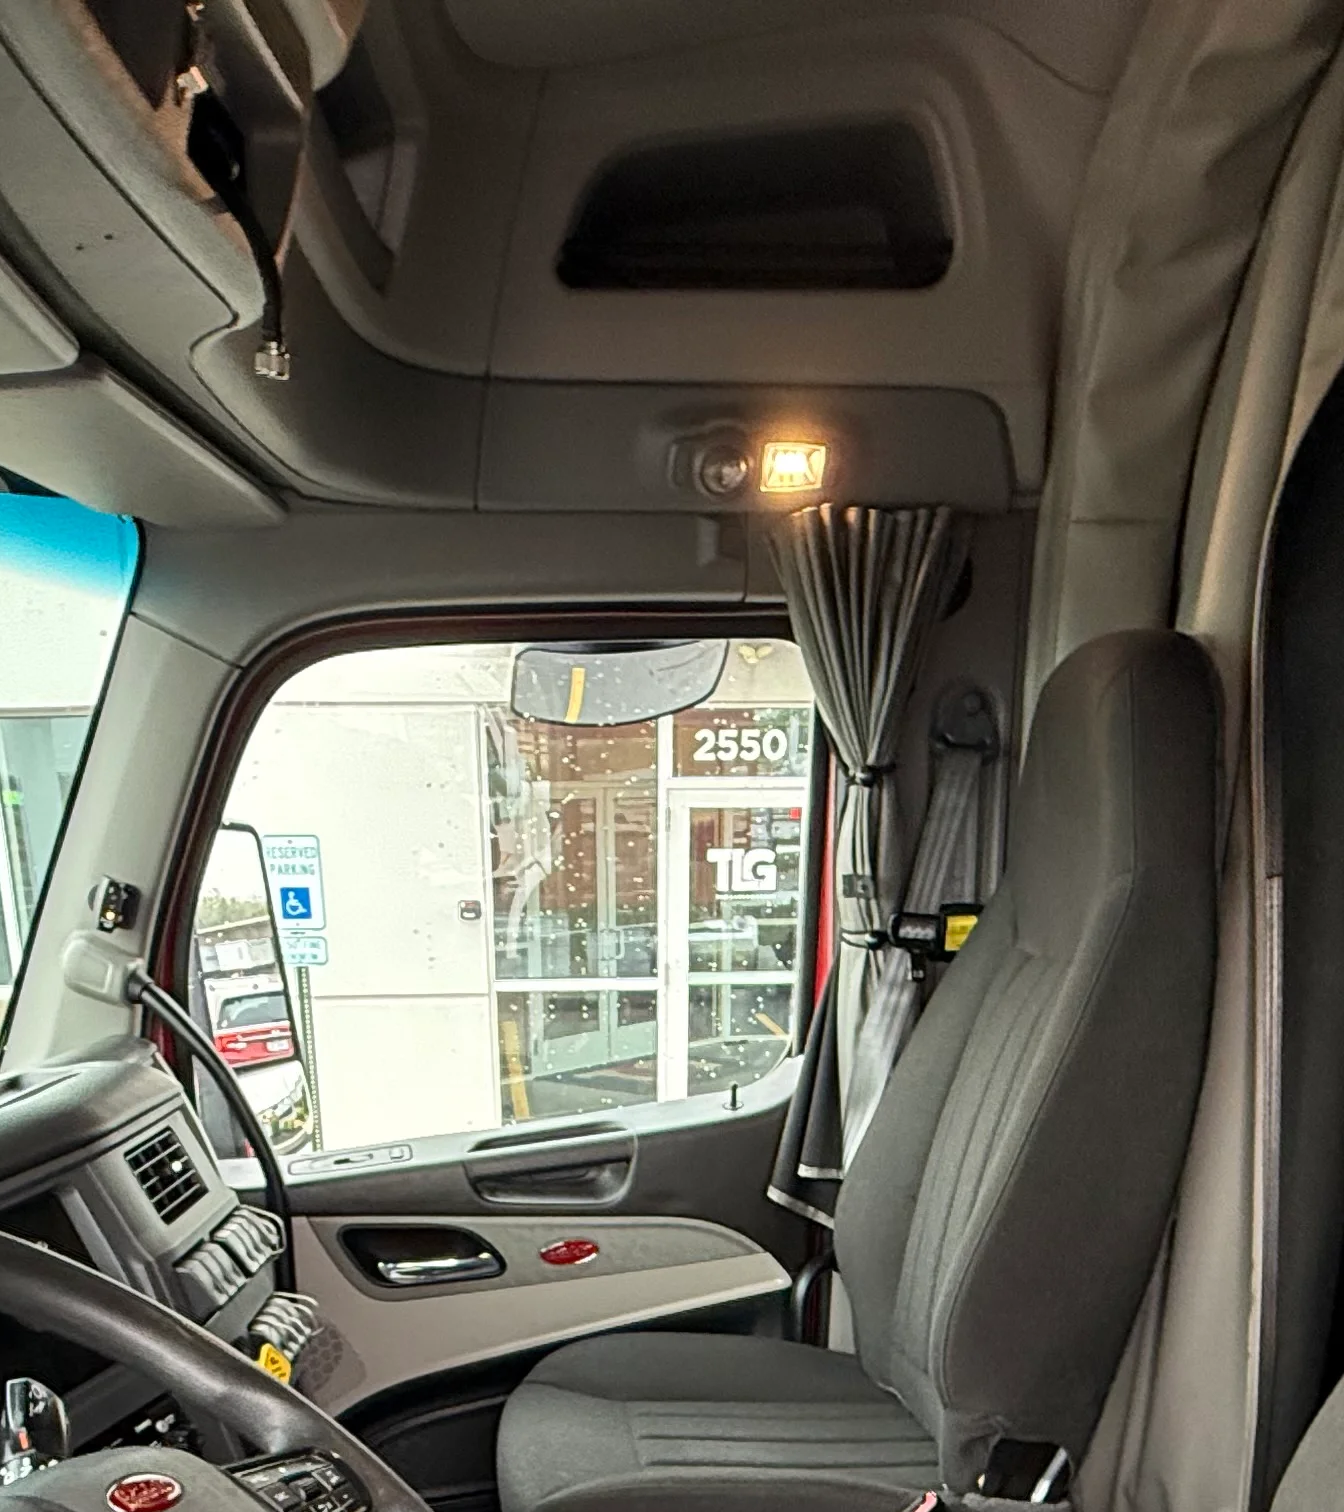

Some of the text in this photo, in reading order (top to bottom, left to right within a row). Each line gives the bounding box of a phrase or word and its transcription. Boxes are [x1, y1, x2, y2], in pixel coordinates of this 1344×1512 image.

[693, 729, 787, 761] 2550
[269, 864, 315, 876] PARKING
[706, 847, 777, 892] TLG
